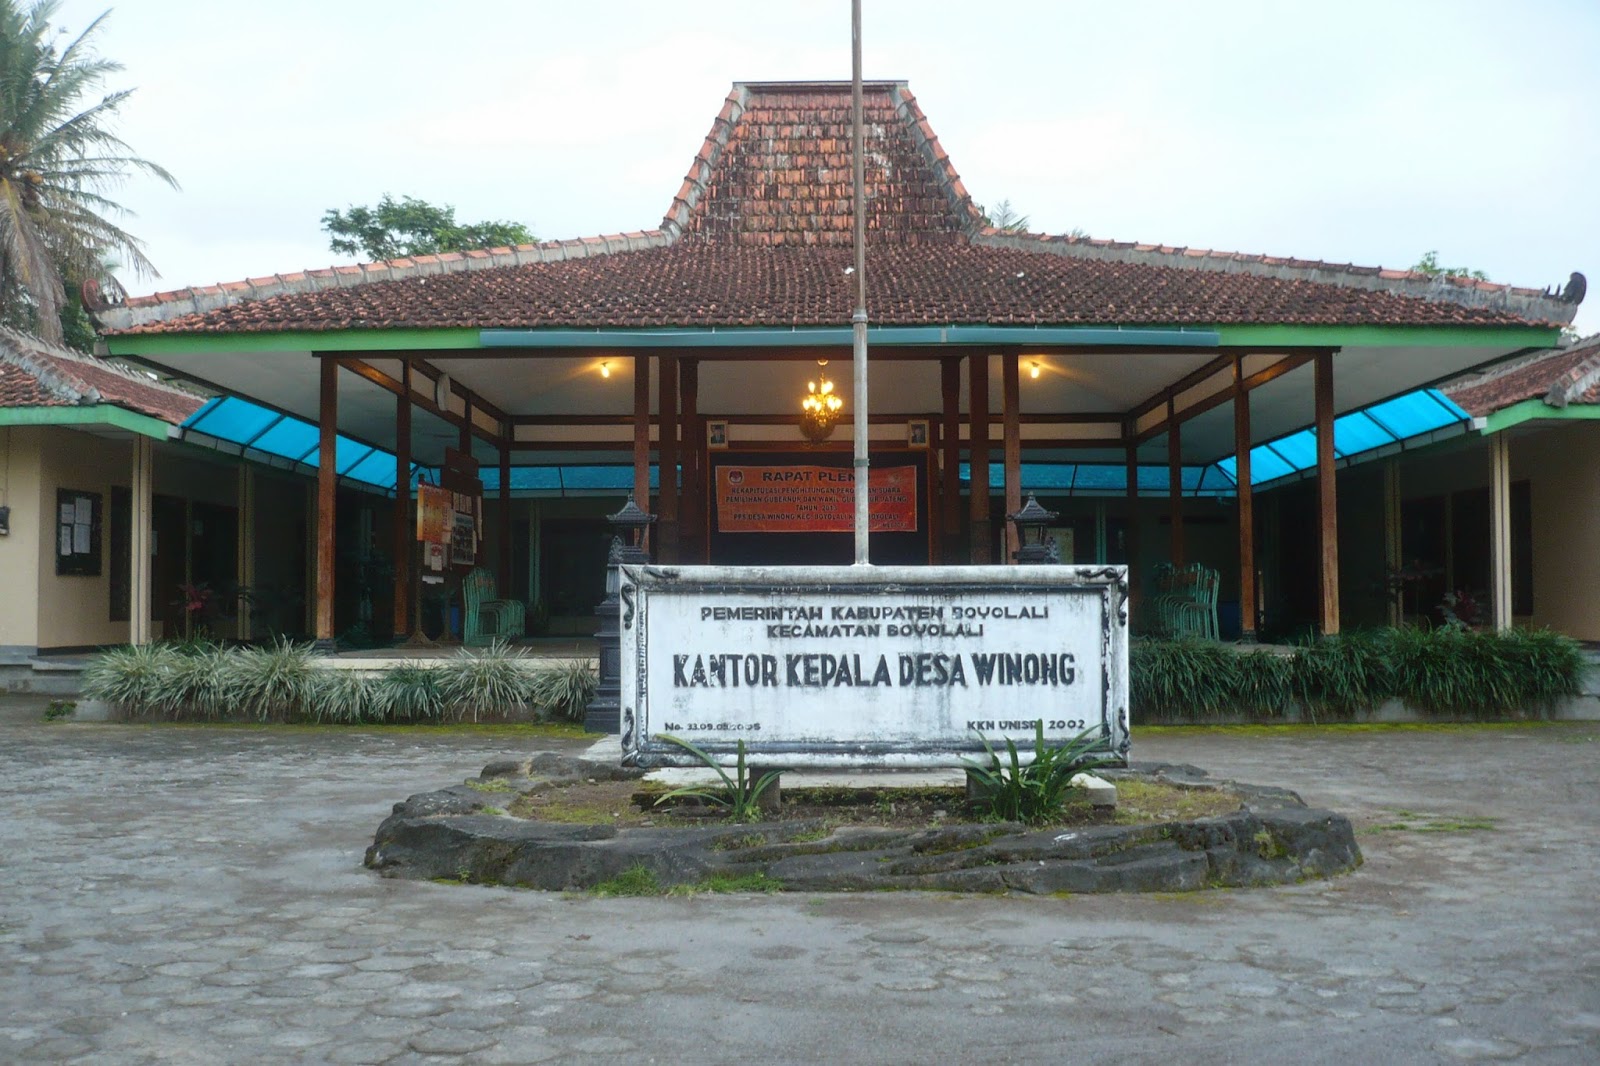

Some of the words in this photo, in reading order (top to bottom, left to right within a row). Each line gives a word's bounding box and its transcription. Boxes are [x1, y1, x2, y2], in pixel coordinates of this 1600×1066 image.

[762, 471, 812, 481] RAPAT
[818, 471, 870, 481] PLEN
[701, 606, 823, 620] PEMERINTAH
[831, 606, 943, 620] KABUPATEN
[952, 606, 1049, 619] BOYOLALI
[767, 624, 880, 638] KECAMATAN
[887, 624, 984, 637] BOYOLALI
[673, 653, 779, 688] KANTOR
[786, 653, 892, 687] KEPALA
[899, 652, 967, 687] DESA
[971, 652, 1076, 687] WINONG
[967, 720, 995, 731] KKN
[999, 720, 1043, 731] UNISR
[1049, 719, 1086, 730] 2002
